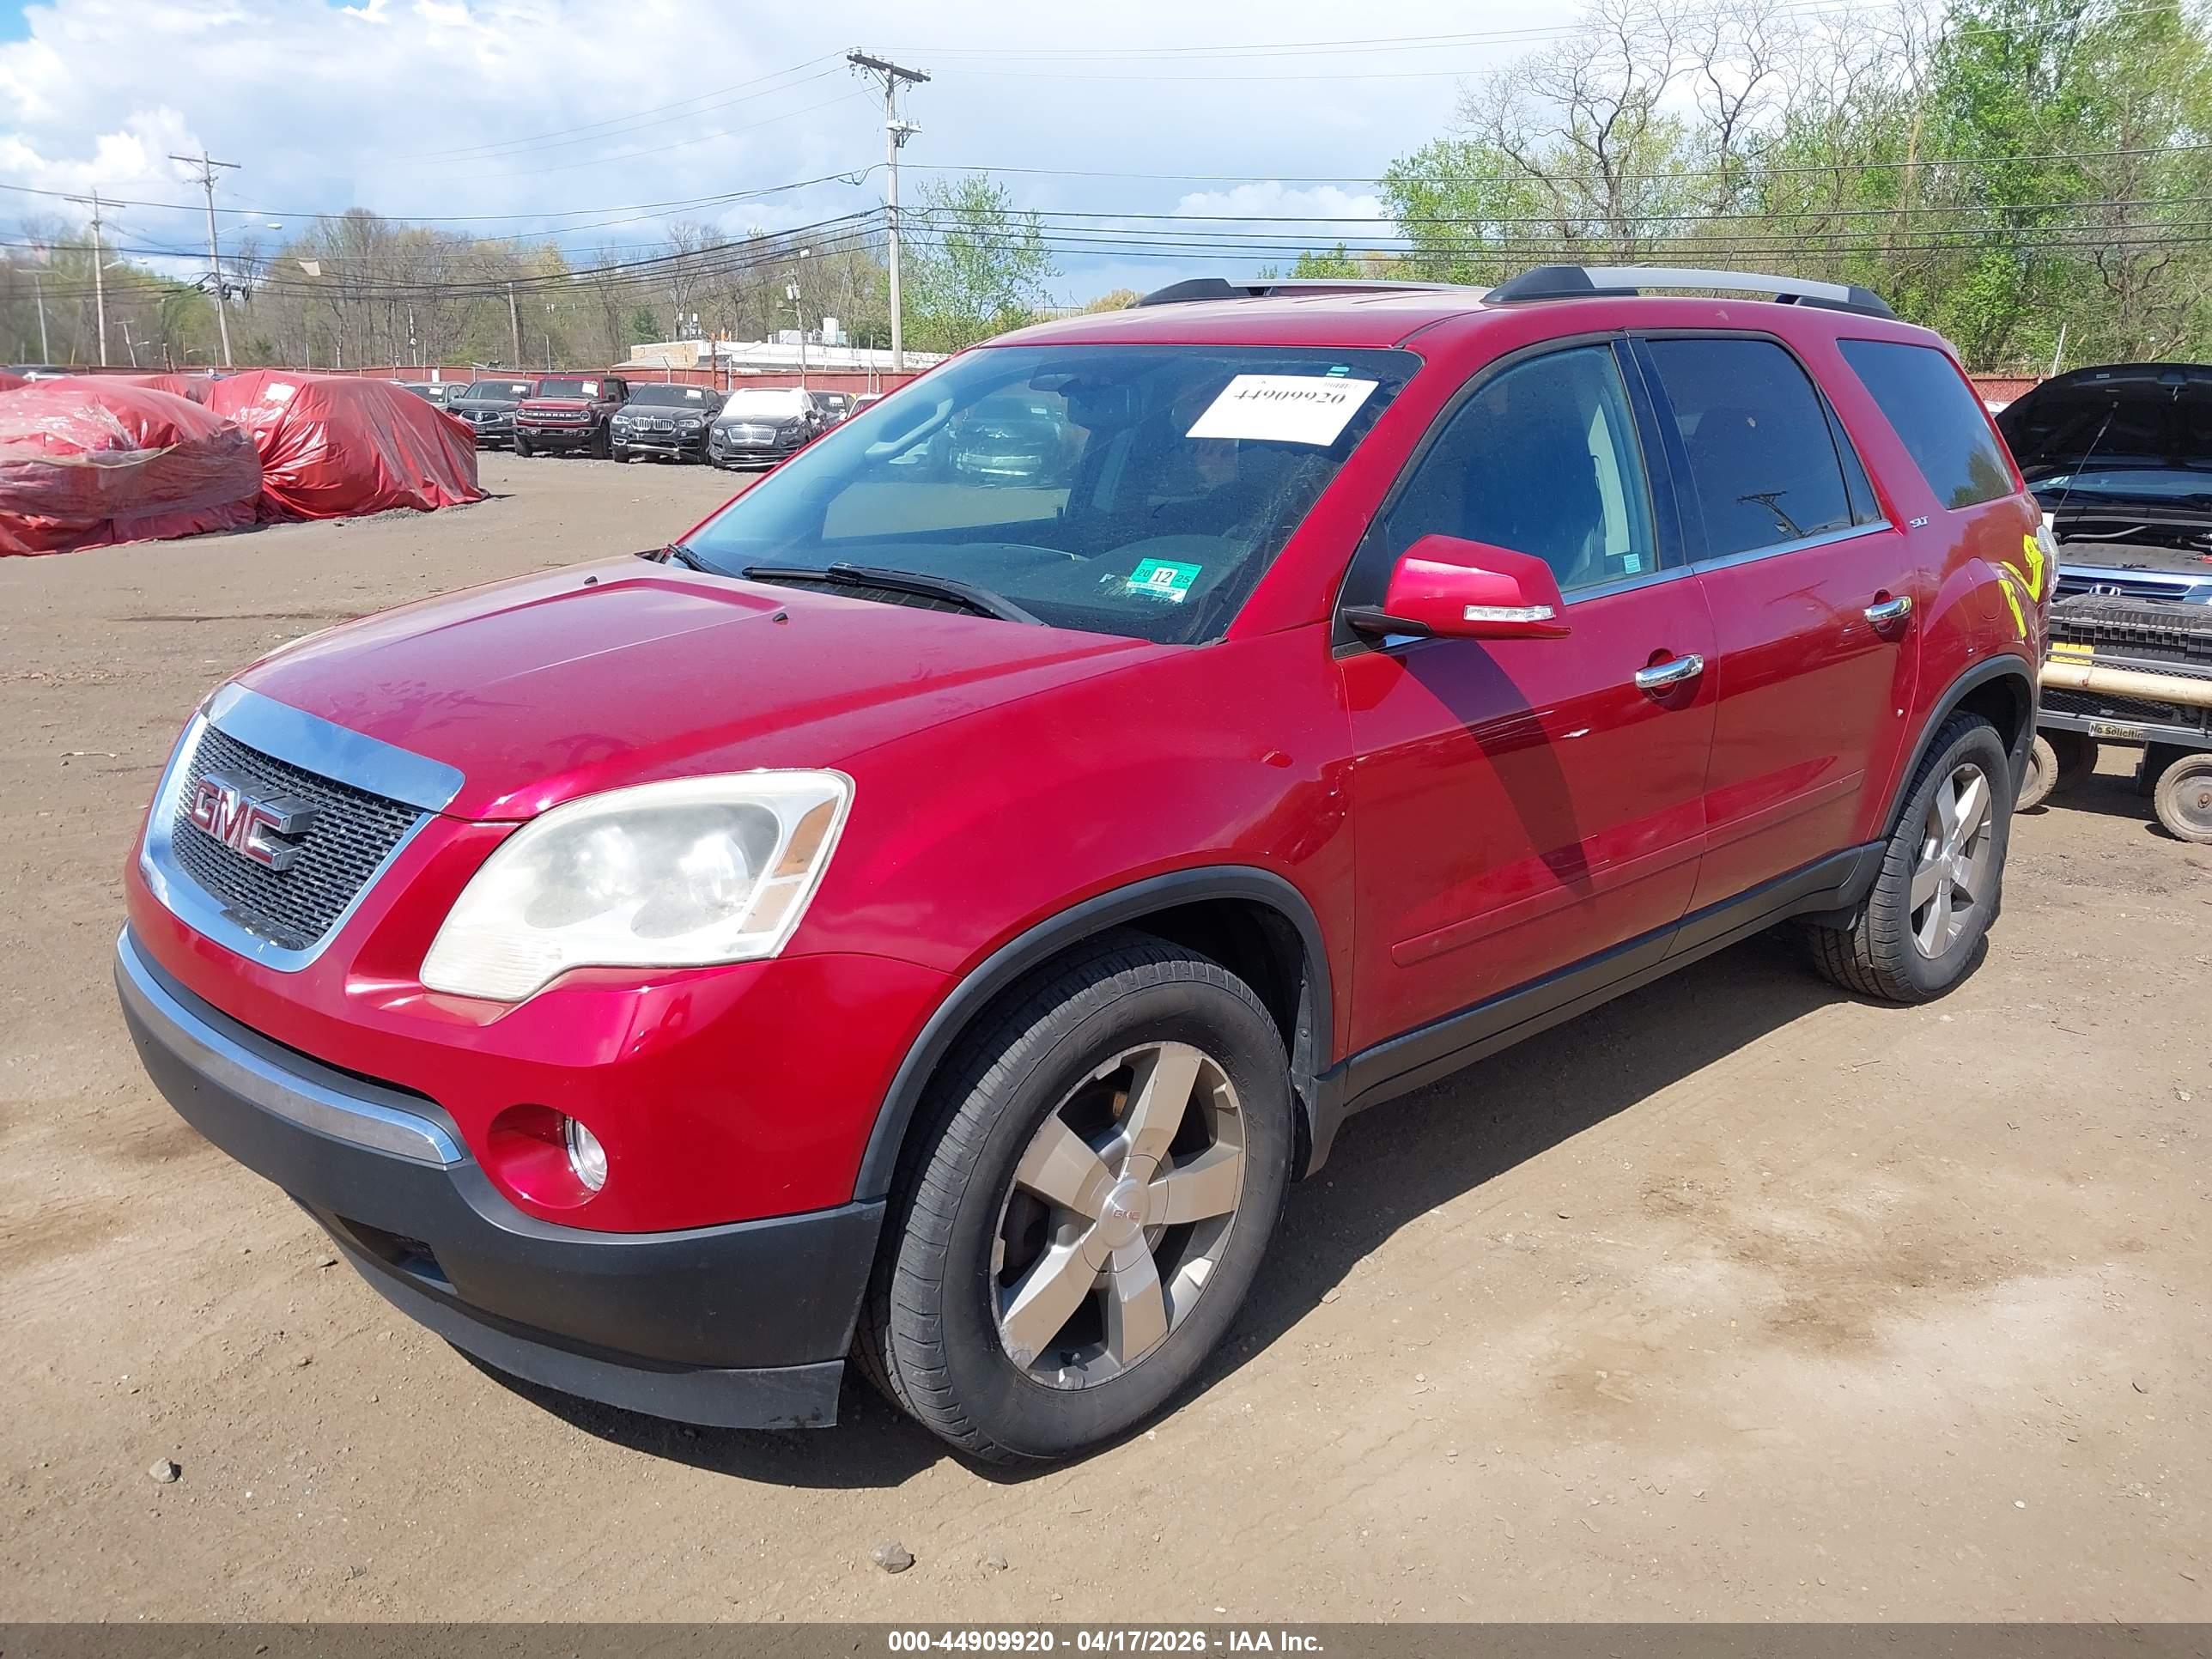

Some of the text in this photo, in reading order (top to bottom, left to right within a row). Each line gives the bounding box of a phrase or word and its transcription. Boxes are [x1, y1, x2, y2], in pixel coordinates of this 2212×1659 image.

[1233, 389, 1346, 404] 44909920
[1909, 515, 1929, 528] SLT
[1136, 568, 1191, 584] 20 12 25
[2089, 724, 2103, 734] No
[191, 773, 293, 872] GMC
[1113, 1209, 1141, 1220] GMC
